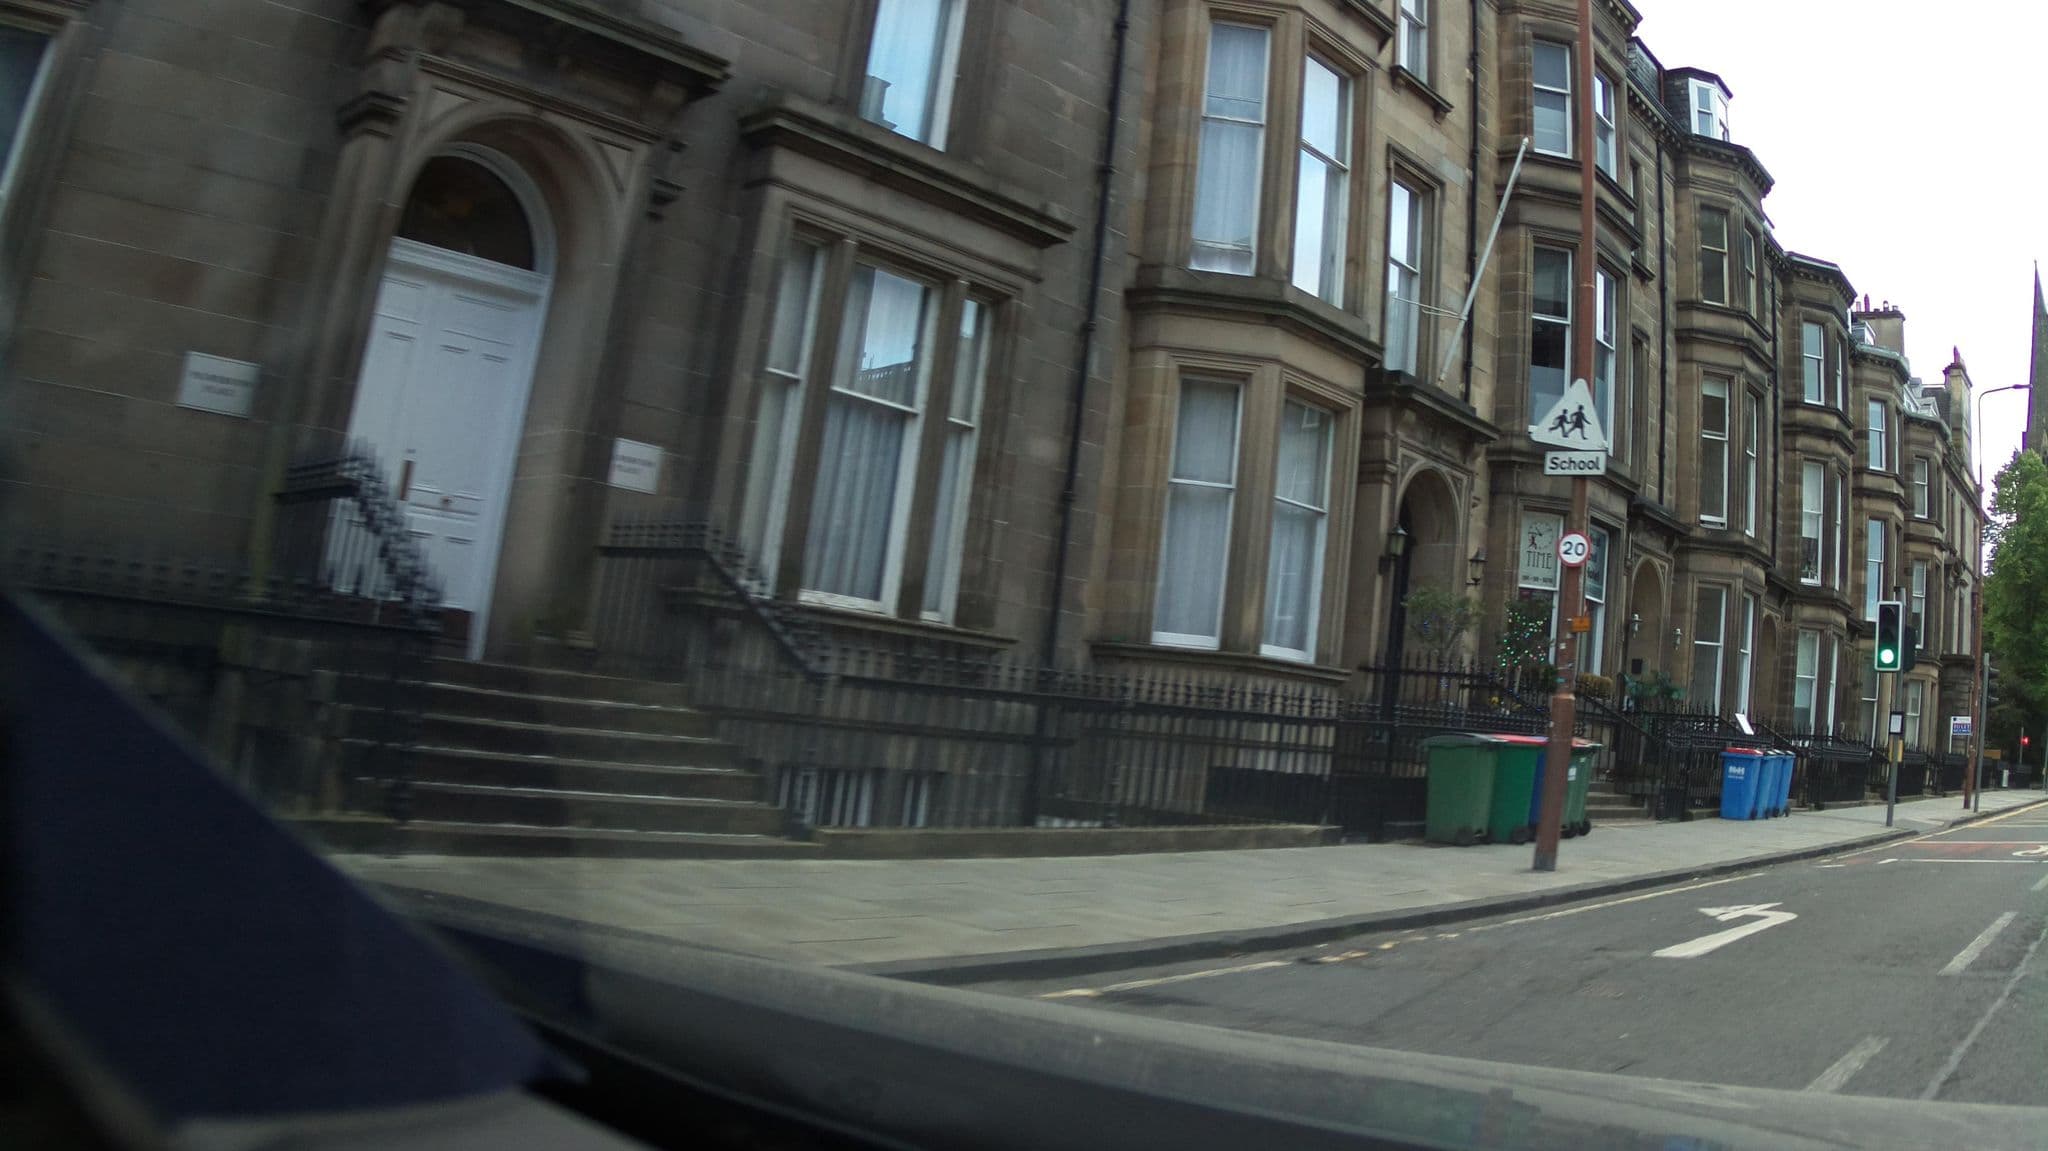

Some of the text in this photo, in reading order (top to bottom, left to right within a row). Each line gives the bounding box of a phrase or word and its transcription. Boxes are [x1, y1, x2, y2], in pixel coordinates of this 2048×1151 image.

[1549, 456, 1600, 470] School
[1562, 541, 1586, 556] 20
[1526, 550, 1552, 569] TIME
